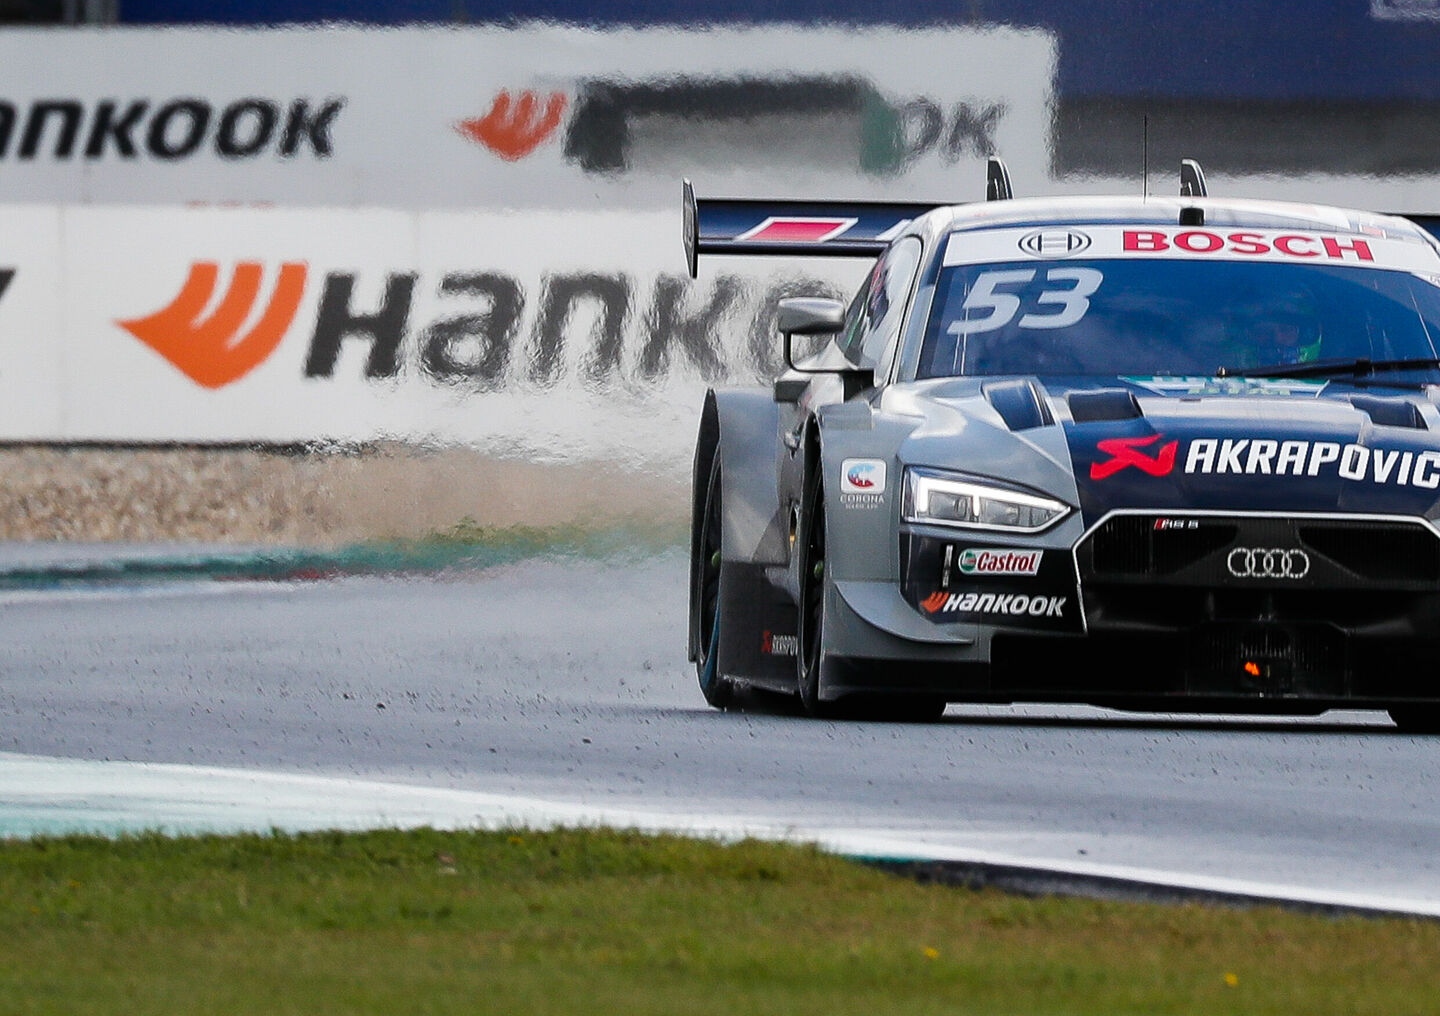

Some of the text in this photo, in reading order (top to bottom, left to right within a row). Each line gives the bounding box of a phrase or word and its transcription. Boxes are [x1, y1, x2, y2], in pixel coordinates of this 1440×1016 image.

[1123, 230, 1375, 262] BOSCH
[947, 267, 1103, 335] 53
[977, 551, 1037, 572] Castrol
